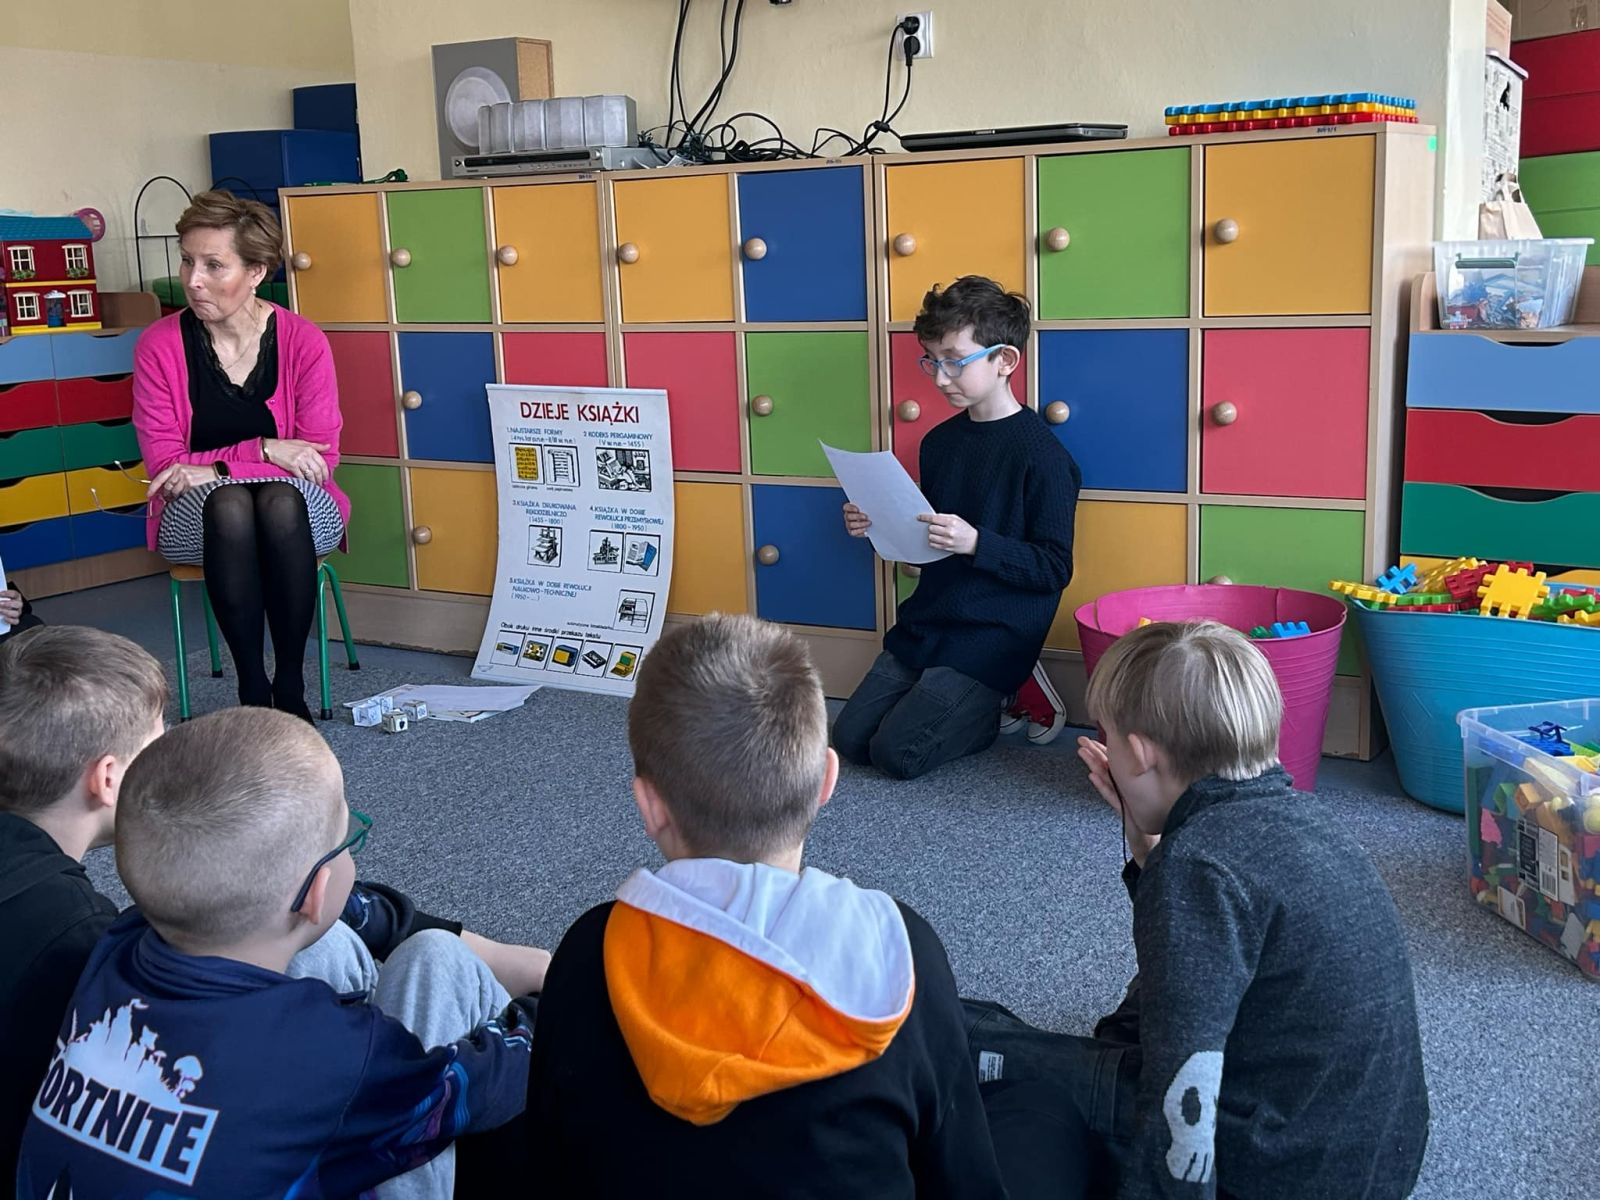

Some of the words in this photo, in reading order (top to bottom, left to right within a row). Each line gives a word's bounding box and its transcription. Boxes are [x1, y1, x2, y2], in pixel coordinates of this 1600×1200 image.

[520, 402, 570, 420] DZIEJE
[577, 401, 640, 426] KSIĄŻKI
[38, 1055, 208, 1175] ORTNITE
